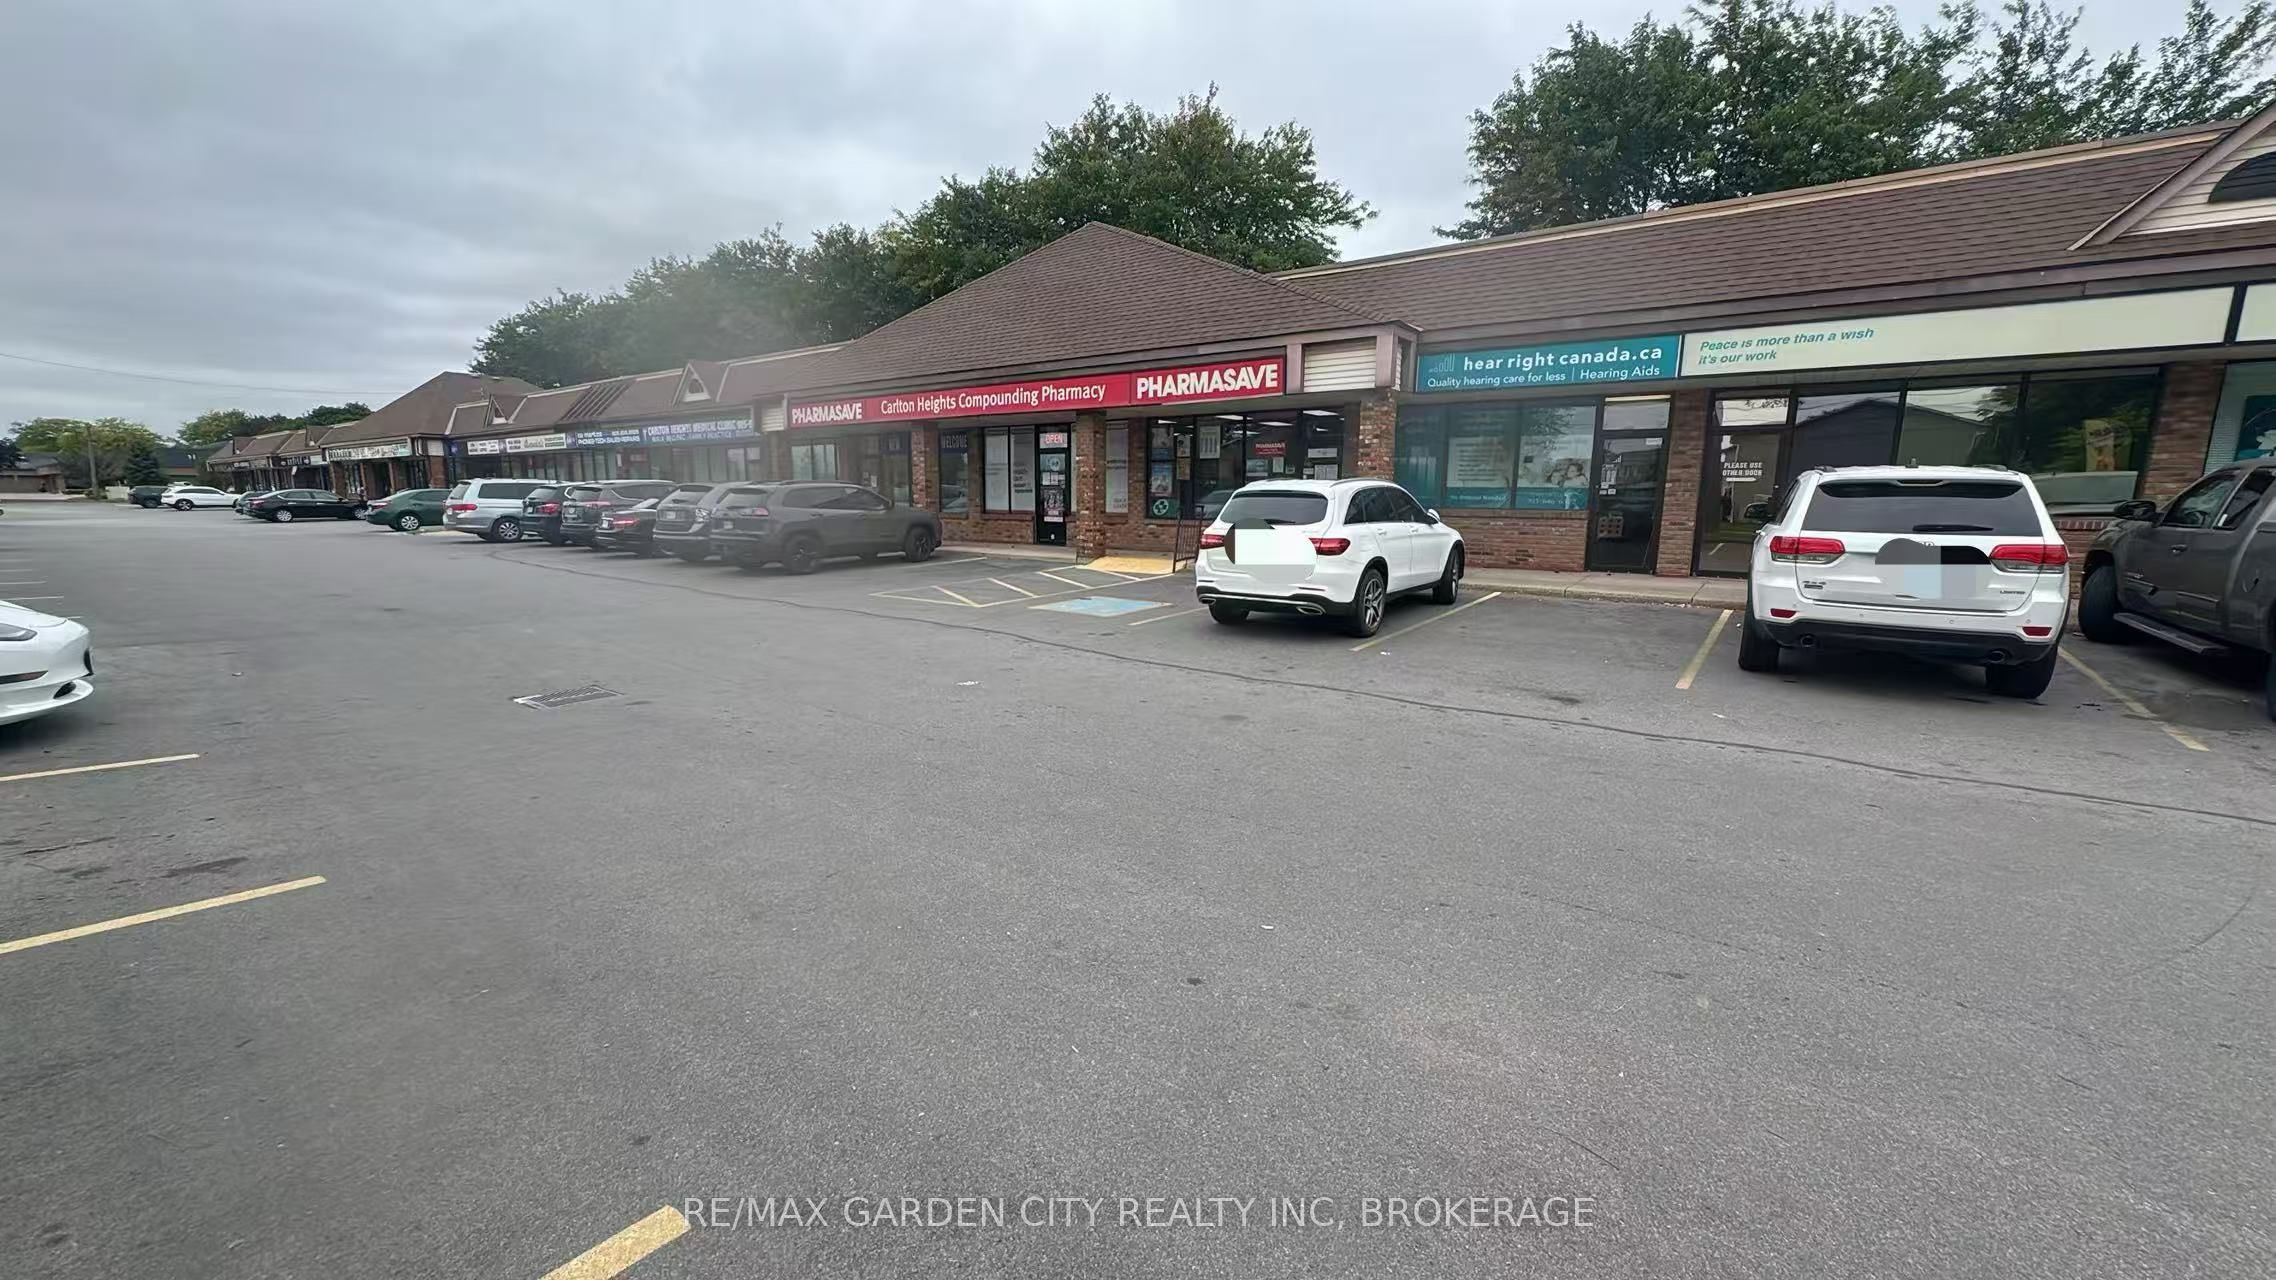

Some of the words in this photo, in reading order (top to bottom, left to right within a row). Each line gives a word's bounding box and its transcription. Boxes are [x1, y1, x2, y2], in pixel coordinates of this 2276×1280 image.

[1700, 341, 1738, 351] Peace
[1741, 338, 1752, 348] is
[1756, 336, 1790, 347] more
[1794, 333, 1824, 344] than
[1827, 331, 1837, 342] a
[1841, 328, 1875, 340] wish
[1463, 357, 1503, 371] hear
[1507, 352, 1555, 371] right
[1559, 346, 1662, 365] canada.ca
[1698, 354, 1717, 365] it's
[1720, 352, 1742, 363] our
[1745, 350, 1777, 361] work
[1136, 364, 1278, 399] PHARMASAVE
[1427, 377, 1462, 388] Quality
[1463, 375, 1501, 387] hearing
[1503, 374, 1525, 384] care
[1527, 371, 1543, 382] for
[1545, 371, 1566, 382] less
[1580, 368, 1629, 380] Hearing
[1631, 364, 1661, 377] Aids
[881, 399, 914, 415] Carlton
[916, 395, 956, 414] Heights
[958, 387, 1040, 410] Compounding
[1041, 384, 1106, 402] Pharmacy
[791, 402, 863, 424] PHARMASAVE
[1044, 433, 1063, 444] OPEN
